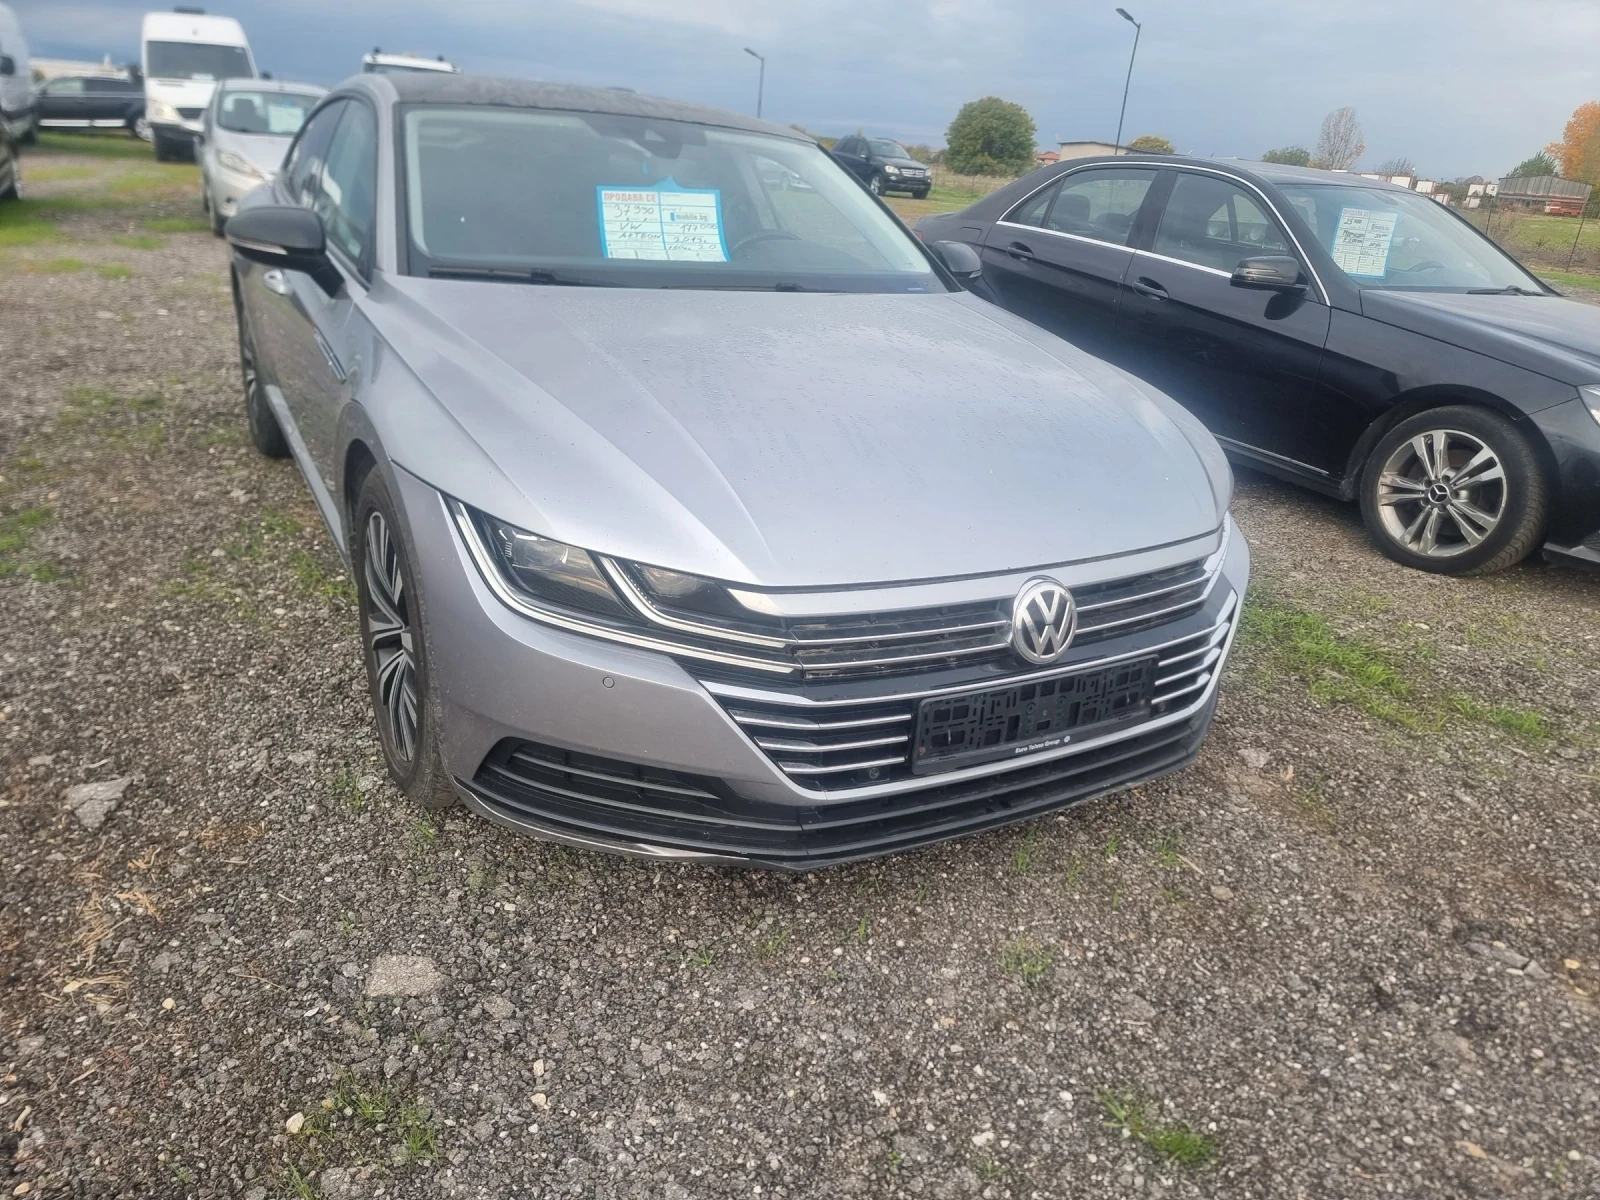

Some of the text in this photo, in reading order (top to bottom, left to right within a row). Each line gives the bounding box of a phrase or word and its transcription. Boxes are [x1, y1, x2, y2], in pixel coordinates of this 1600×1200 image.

[604, 193, 644, 201] ПРОДАВА
[646, 194, 656, 202] СЕ
[1015, 582, 1076, 662] VW
[1015, 738, 1061, 754] Euro Tehno Group
